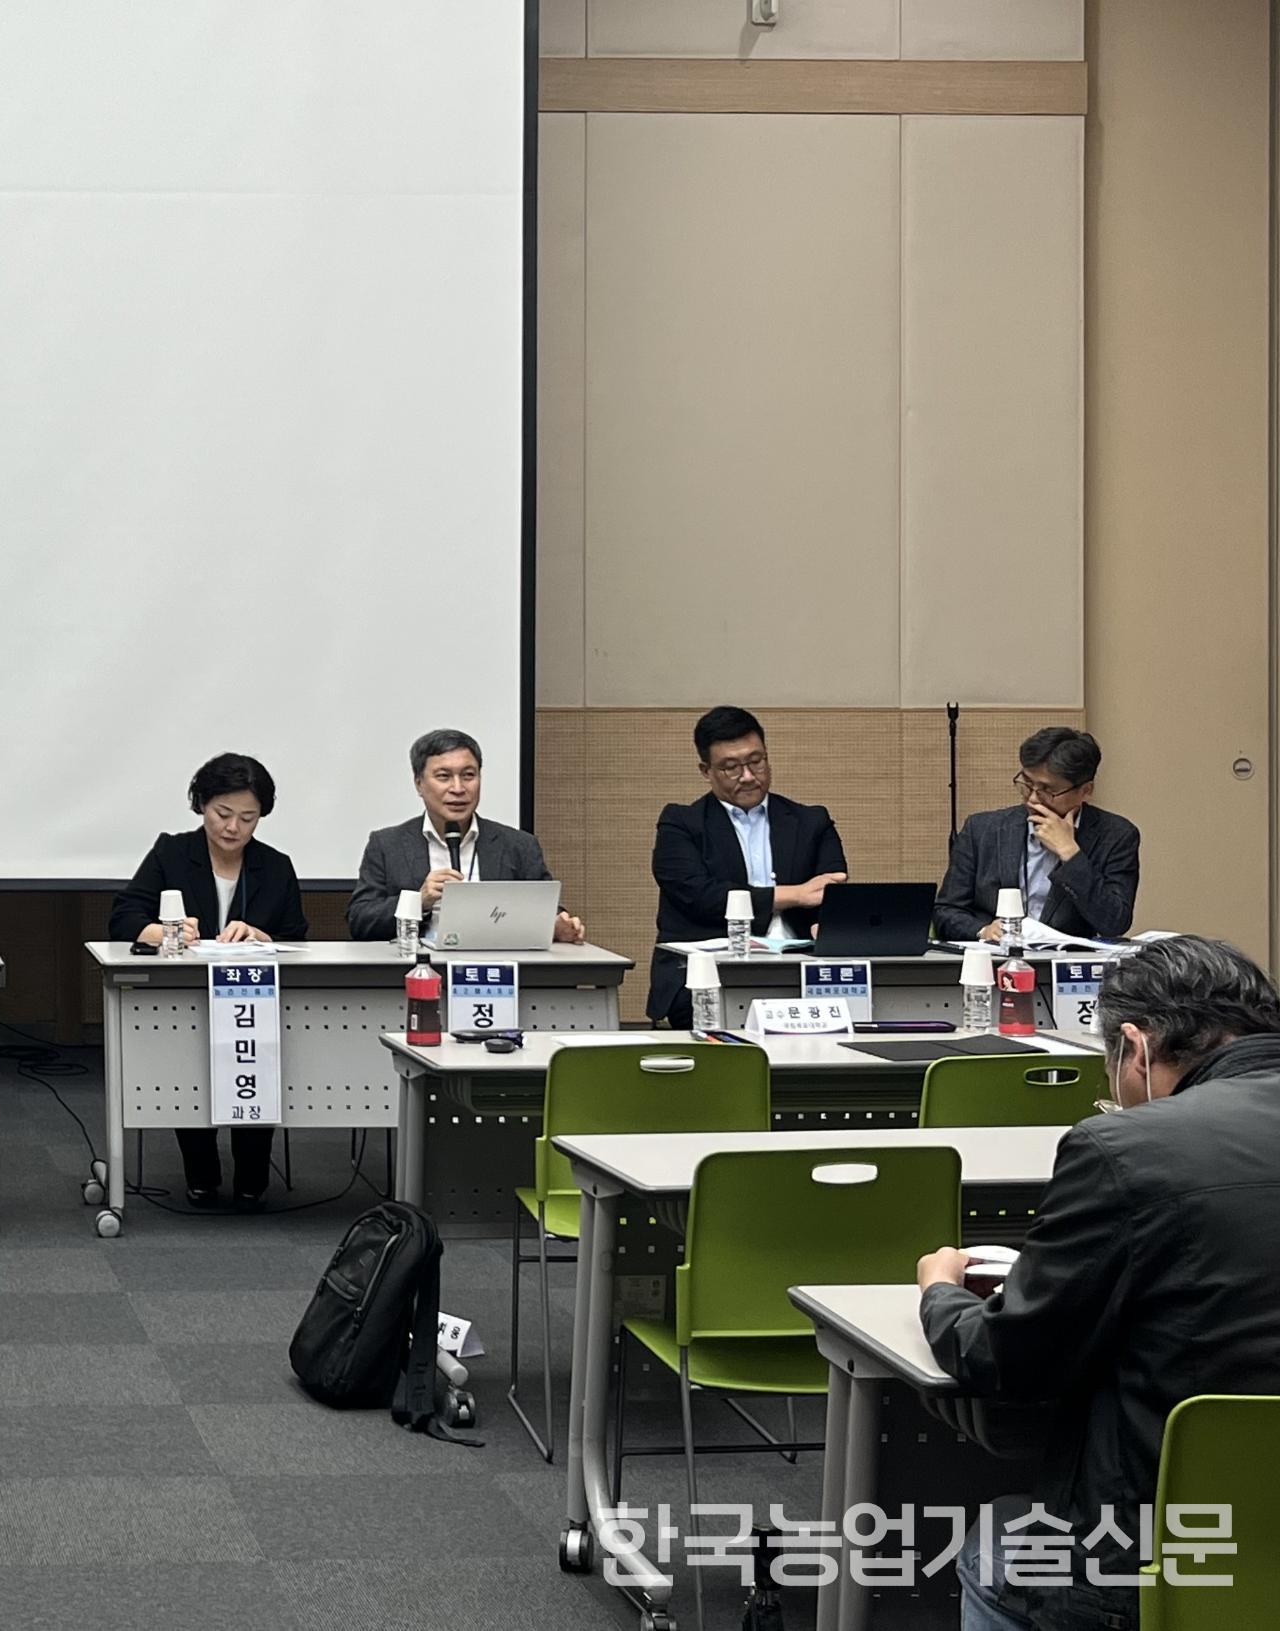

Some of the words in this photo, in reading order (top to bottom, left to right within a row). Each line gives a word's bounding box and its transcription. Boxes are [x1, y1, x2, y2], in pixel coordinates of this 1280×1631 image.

[490, 906, 507, 923] hp
[226, 968, 263, 983] 좌장
[465, 968, 501, 982] 토론
[818, 967, 854, 982] 토론
[232, 1105, 261, 1120] 과장
